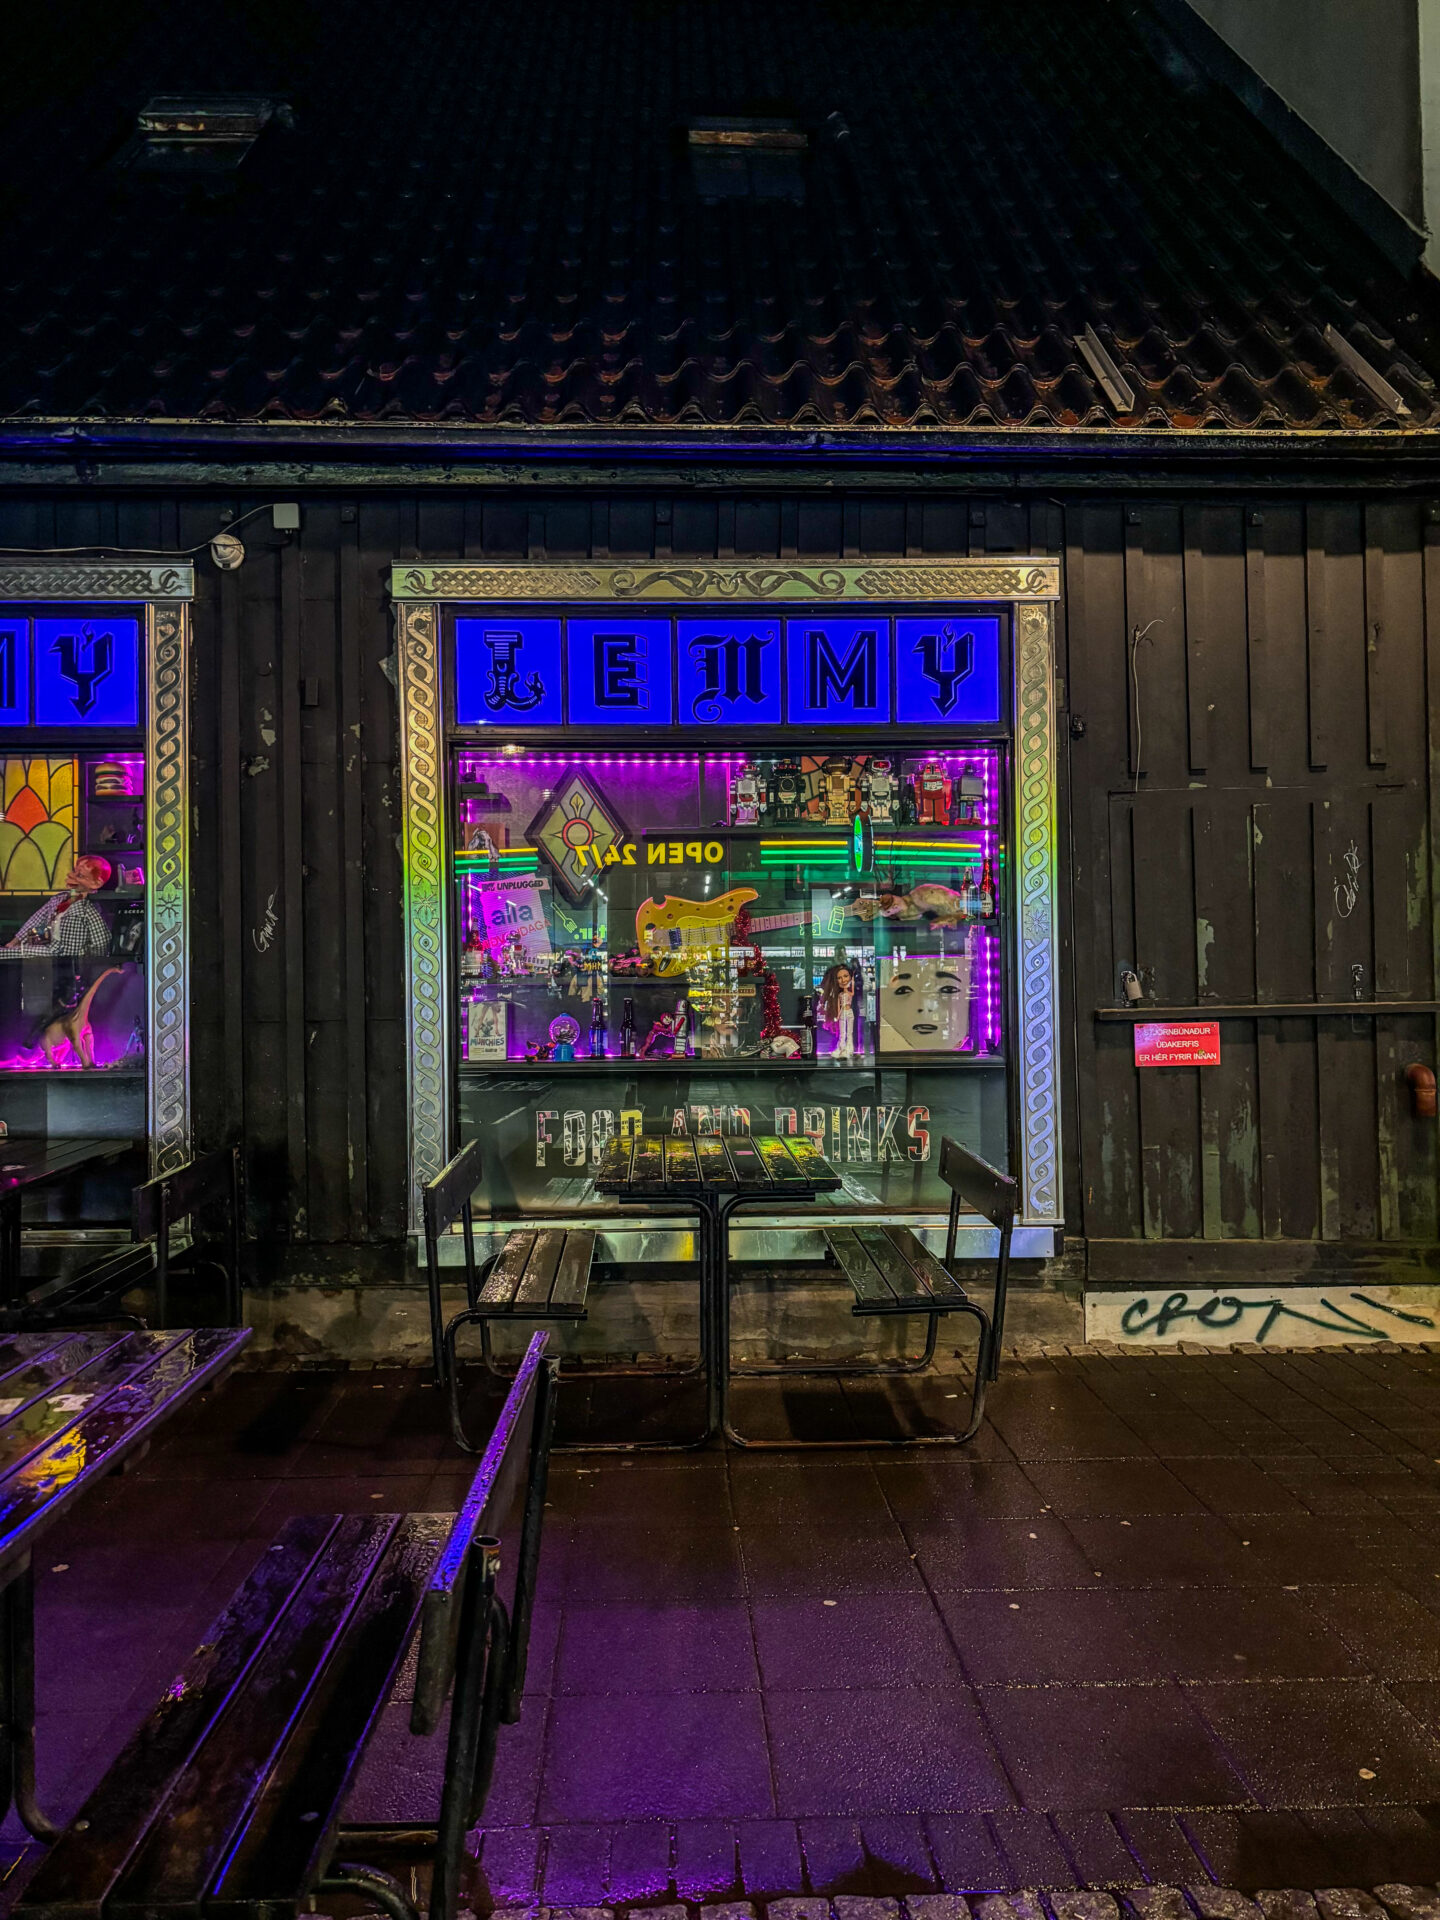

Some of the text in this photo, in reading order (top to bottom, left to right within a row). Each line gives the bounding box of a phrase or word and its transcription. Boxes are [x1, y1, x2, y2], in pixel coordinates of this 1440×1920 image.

[0, 622, 115, 718] Y
[484, 622, 975, 723] LEMMY
[496, 879, 543, 892] UNPLUGGED
[1139, 1051, 1217, 1062] ER HÉR FYRIR INNAN
[774, 1105, 931, 1163] DRINKS
